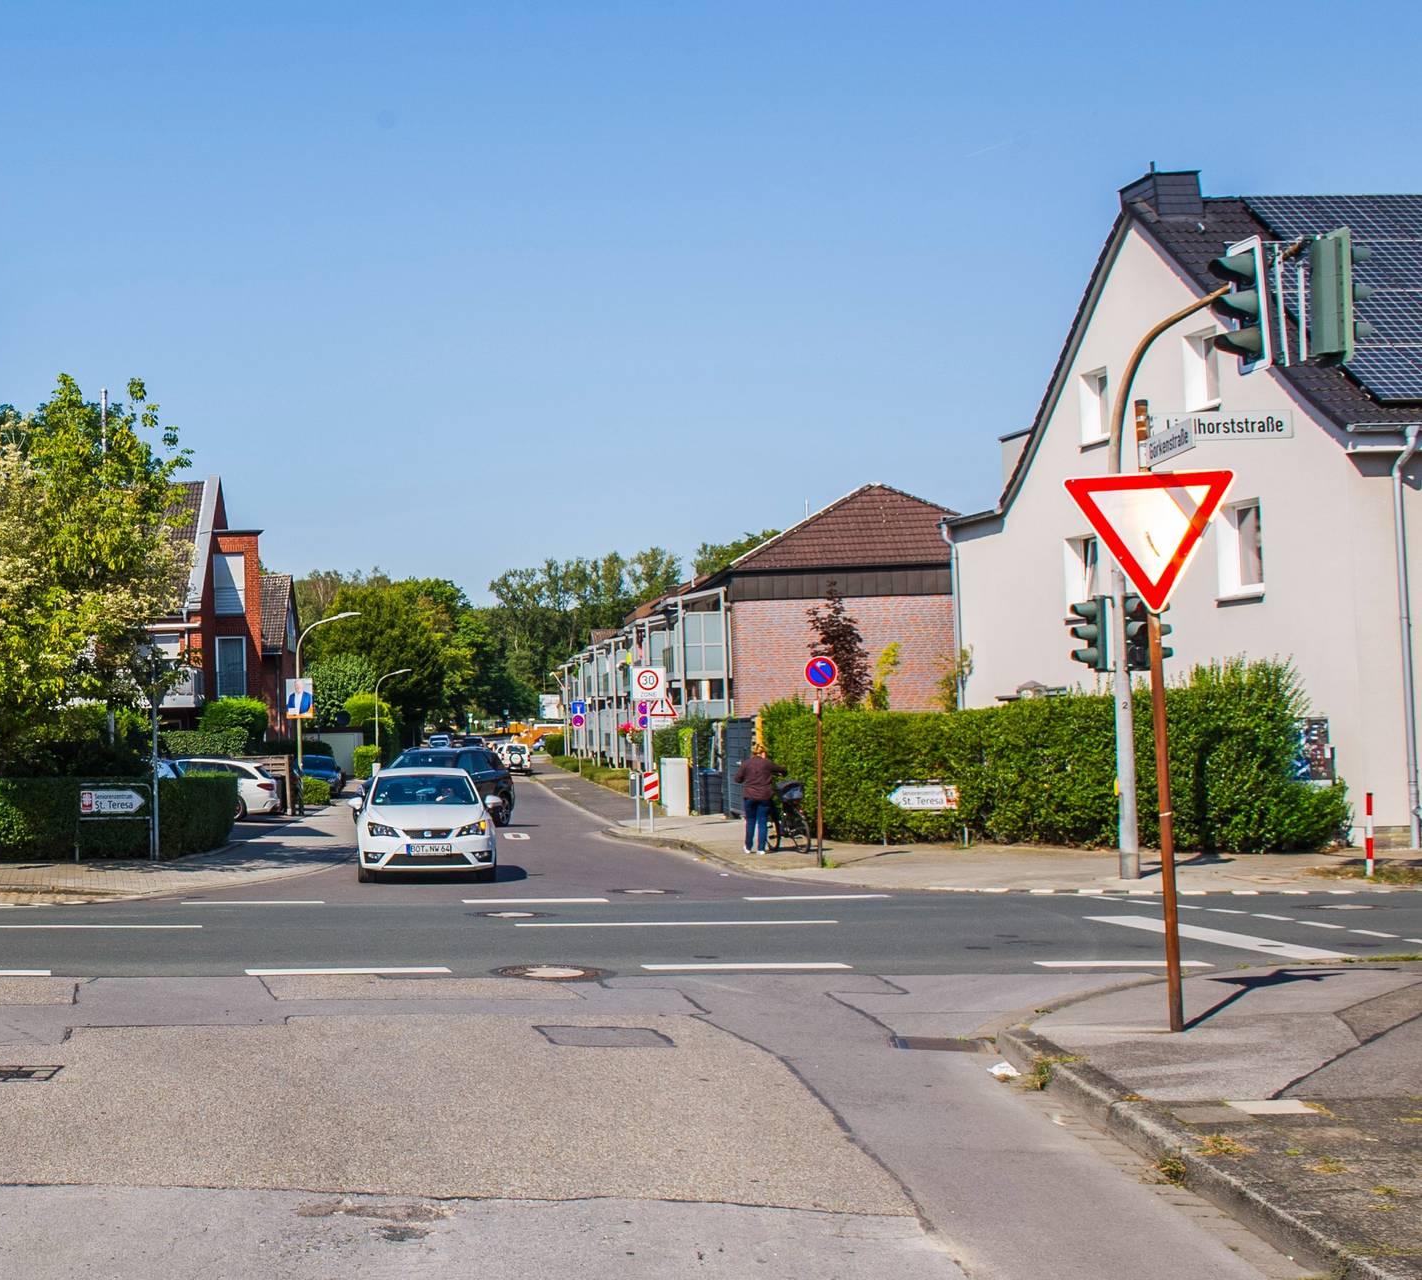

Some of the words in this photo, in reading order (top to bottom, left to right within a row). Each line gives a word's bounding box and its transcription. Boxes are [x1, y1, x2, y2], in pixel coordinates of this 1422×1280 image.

[1166, 416, 1284, 435] horststraße
[641, 675, 655, 685] 30
[1122, 701, 1128, 709] 2
[94, 801, 106, 809] St.
[108, 800, 134, 809] Teresa
[901, 797, 914, 805] St.
[915, 797, 944, 805] Teresa
